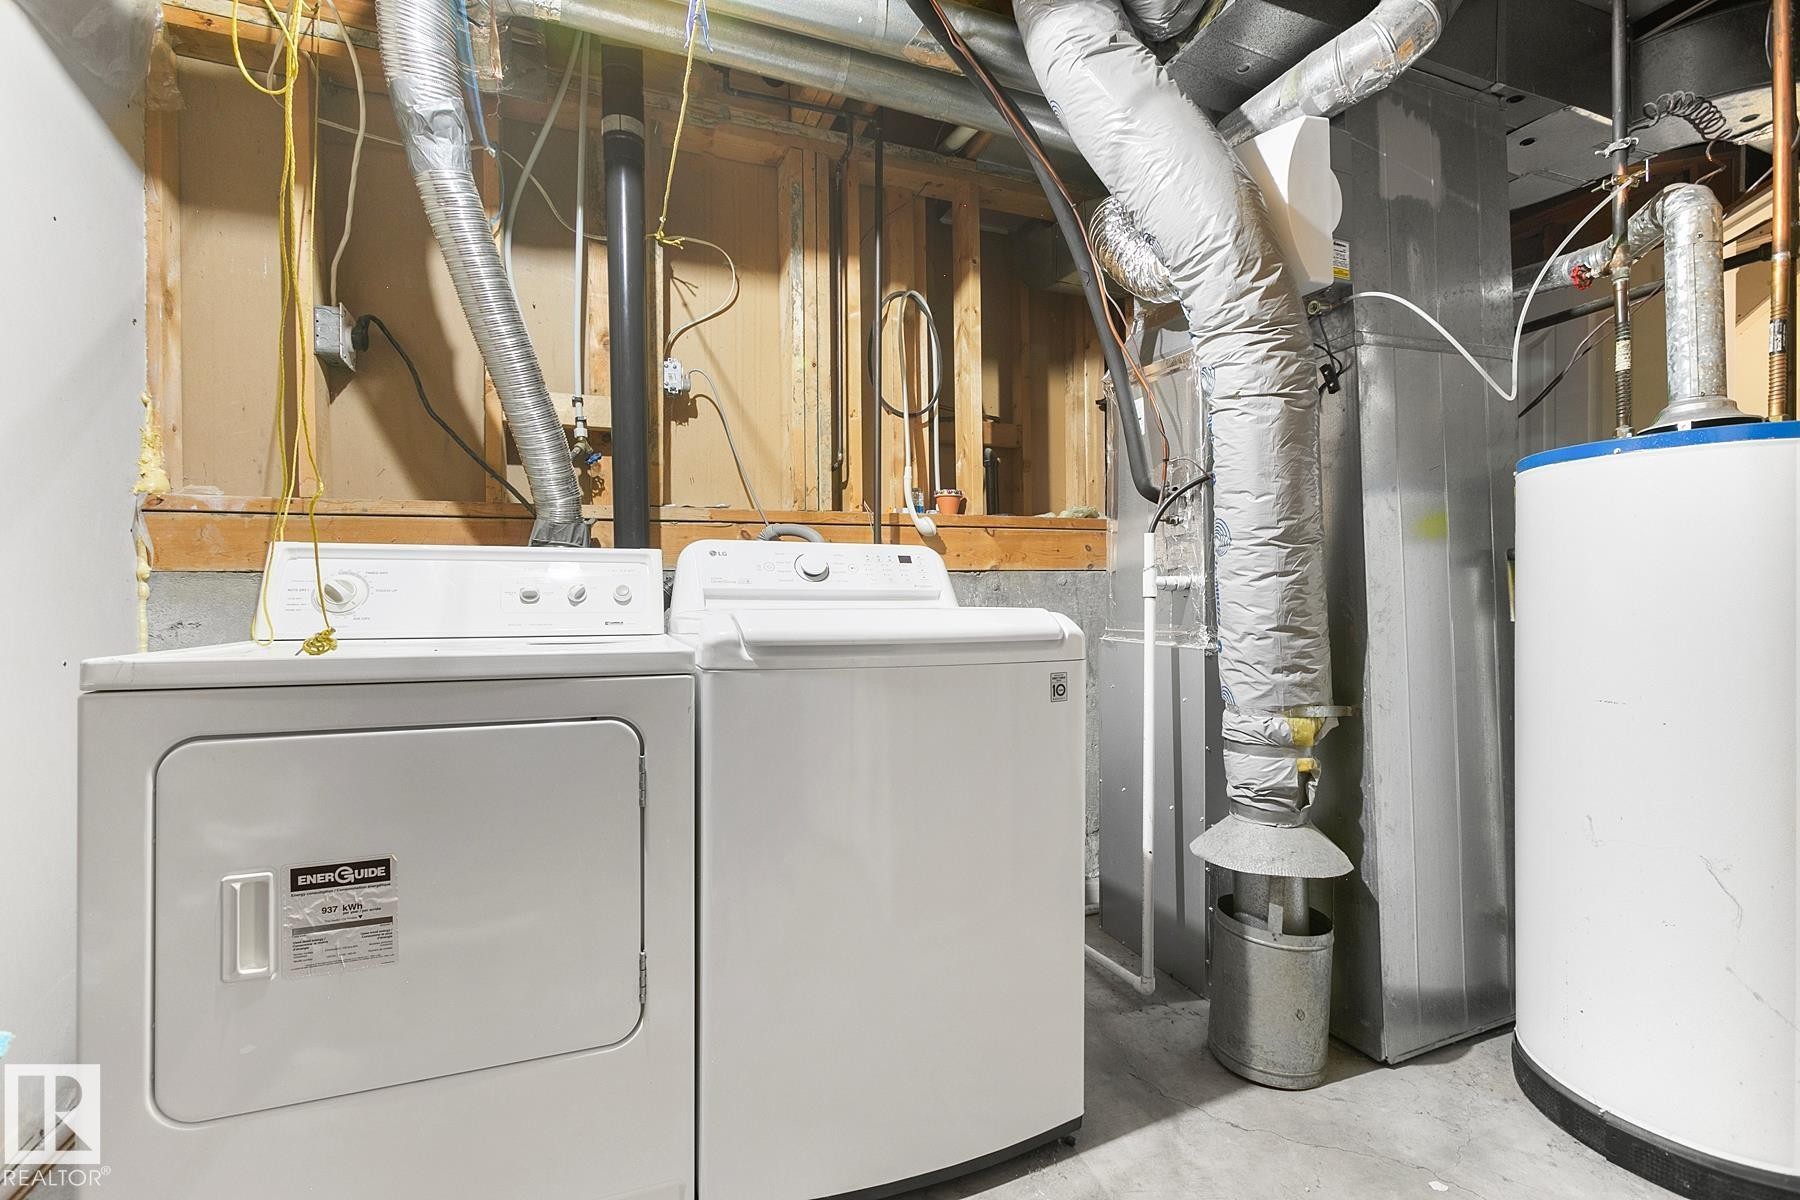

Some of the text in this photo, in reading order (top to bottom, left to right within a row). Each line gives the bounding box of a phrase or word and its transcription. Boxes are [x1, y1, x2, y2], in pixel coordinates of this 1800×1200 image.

[1052, 683, 1066, 697] 10
[321, 902, 363, 915] 937 kWh
